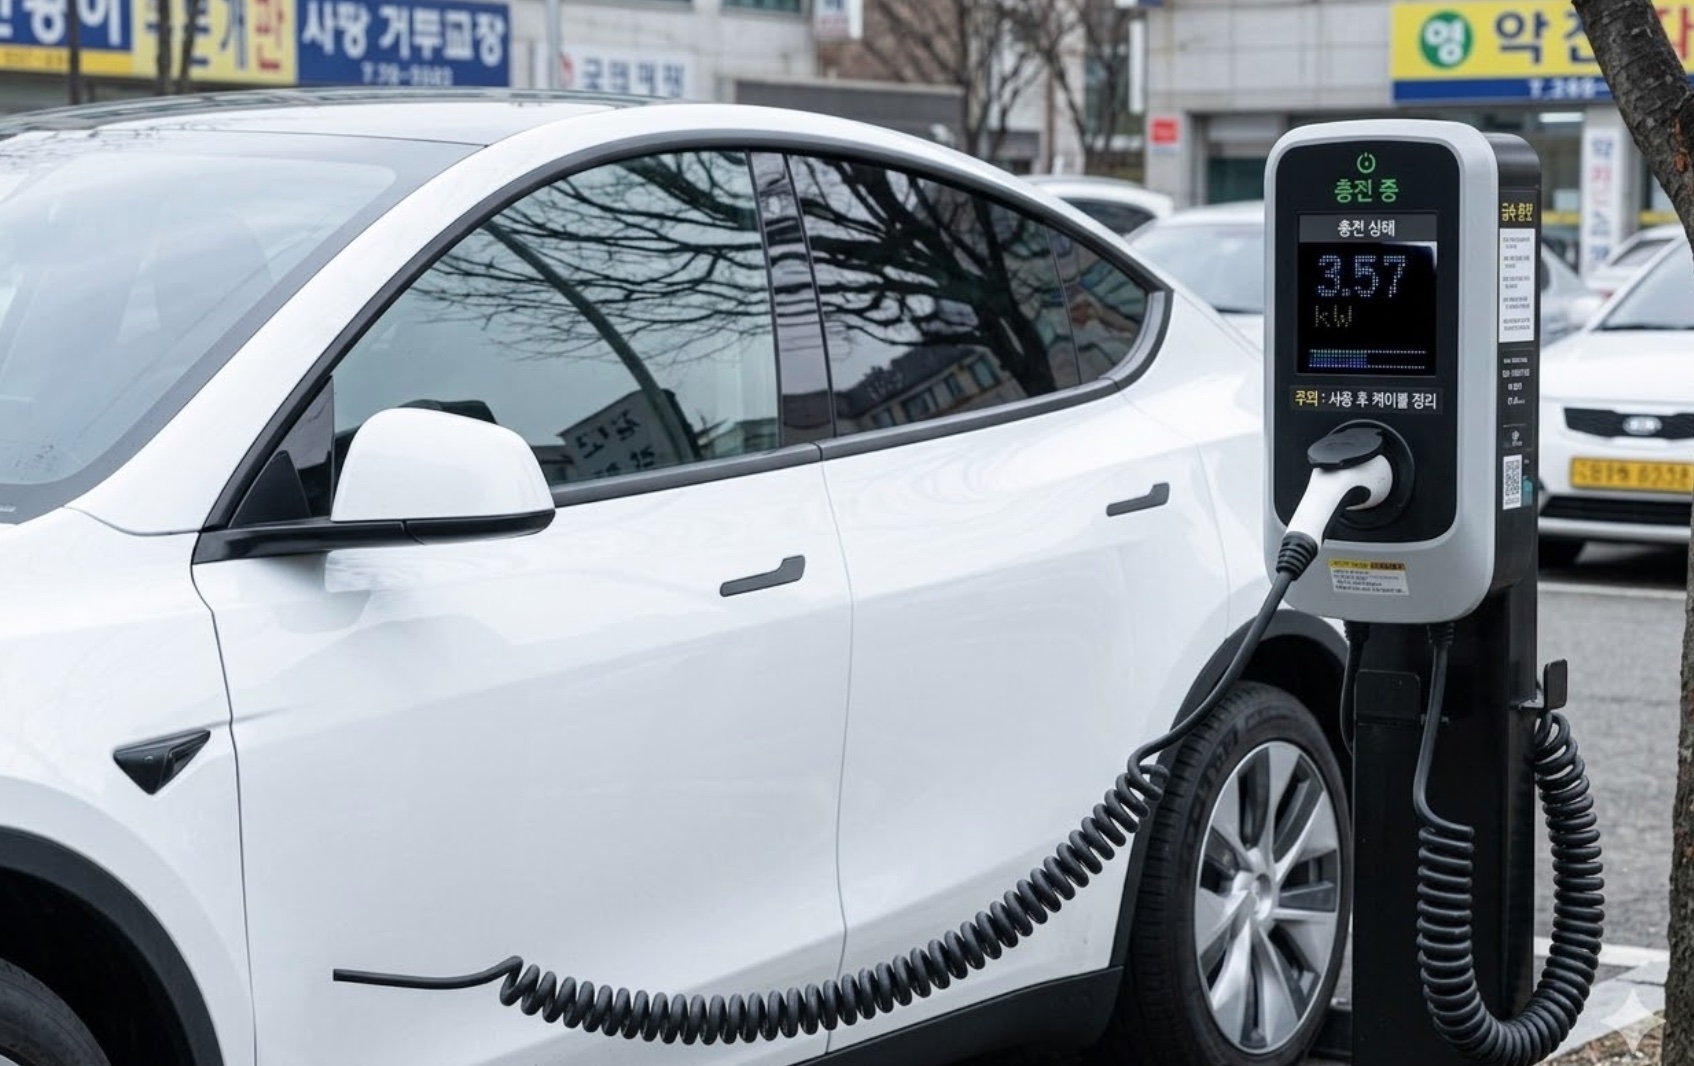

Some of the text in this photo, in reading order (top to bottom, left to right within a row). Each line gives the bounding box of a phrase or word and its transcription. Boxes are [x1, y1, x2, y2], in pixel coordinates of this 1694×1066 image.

[1425, 19, 1466, 65] 영
[1317, 254, 1406, 298] 3.57
[1314, 304, 1353, 328] kW
